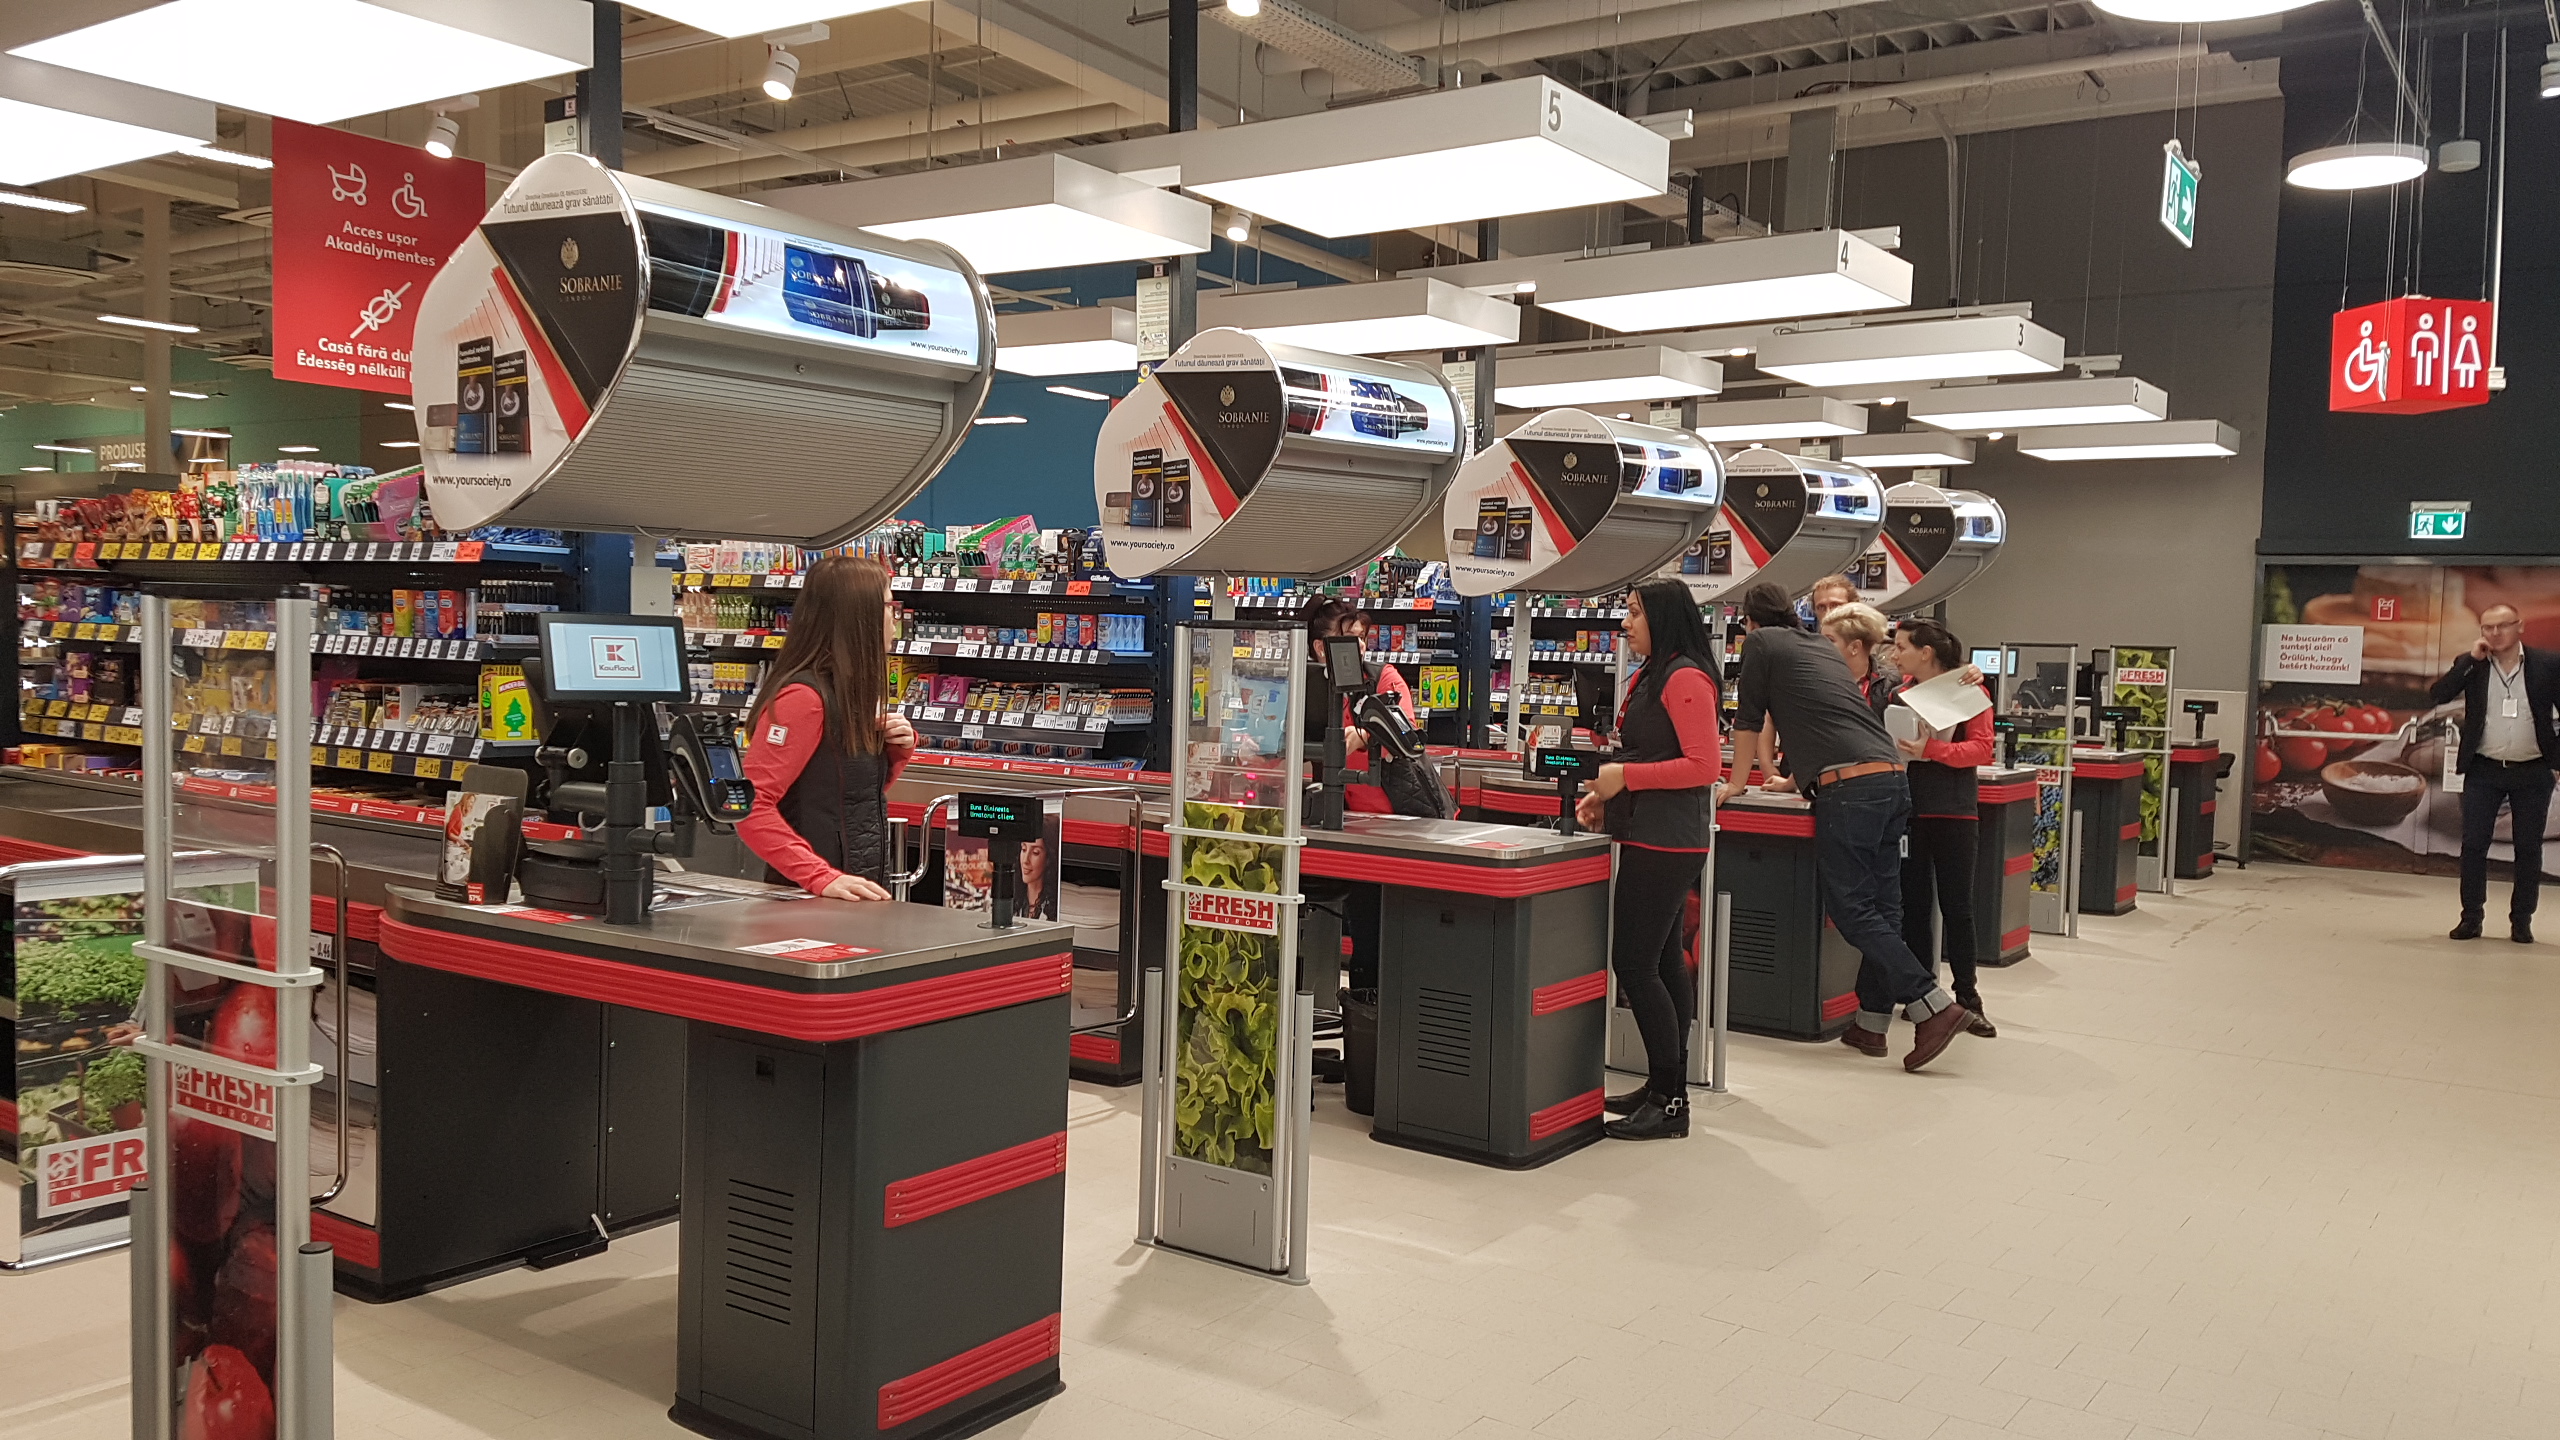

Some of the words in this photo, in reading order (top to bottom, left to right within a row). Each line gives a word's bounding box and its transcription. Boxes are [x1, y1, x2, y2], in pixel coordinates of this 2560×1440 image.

[1547, 90, 1562, 131] 5
[503, 202, 529, 215] Tutunul
[530, 198, 564, 212] dăunează
[565, 198, 581, 211] grav
[343, 221, 384, 240] Acces
[325, 235, 436, 266] Akadálymentes
[1840, 240, 1850, 270] 4
[560, 274, 623, 294] SOBRANIE
[2018, 323, 2024, 346] 3
[318, 337, 354, 355] Casă
[357, 342, 388, 360] fără
[911, 340, 968, 357] www.yoursociety.ro
[297, 349, 356, 376] Édesség
[359, 361, 406, 379] nélküli
[1174, 358, 1195, 369] Tutunul
[1226, 358, 1239, 369] grav
[2134, 382, 2139, 403] 2
[1218, 410, 1270, 425] SOBRANIE
[100, 442, 146, 461] PRODUSE
[432, 473, 512, 490] www.yoursociety.ro
[1561, 472, 1609, 484] SOBRANIE
[1755, 500, 1796, 508] SOBRANIE
[1110, 540, 1175, 552] www.yoursociety.ro
[1455, 564, 1515, 578] www.yoursociety.ro
[2280, 662, 2307, 670] betért
[2320, 654, 2343, 664] hogy
[599, 664, 636, 673] Kaufland
[2127, 670, 2164, 680] FRESH
[1202, 893, 1274, 920] FRESH
[1215, 916, 1272, 929] EUROPA
[191, 1067, 274, 1115] FRESH
[206, 1102, 273, 1129] EUROPA
[83, 1138, 146, 1182] FR
